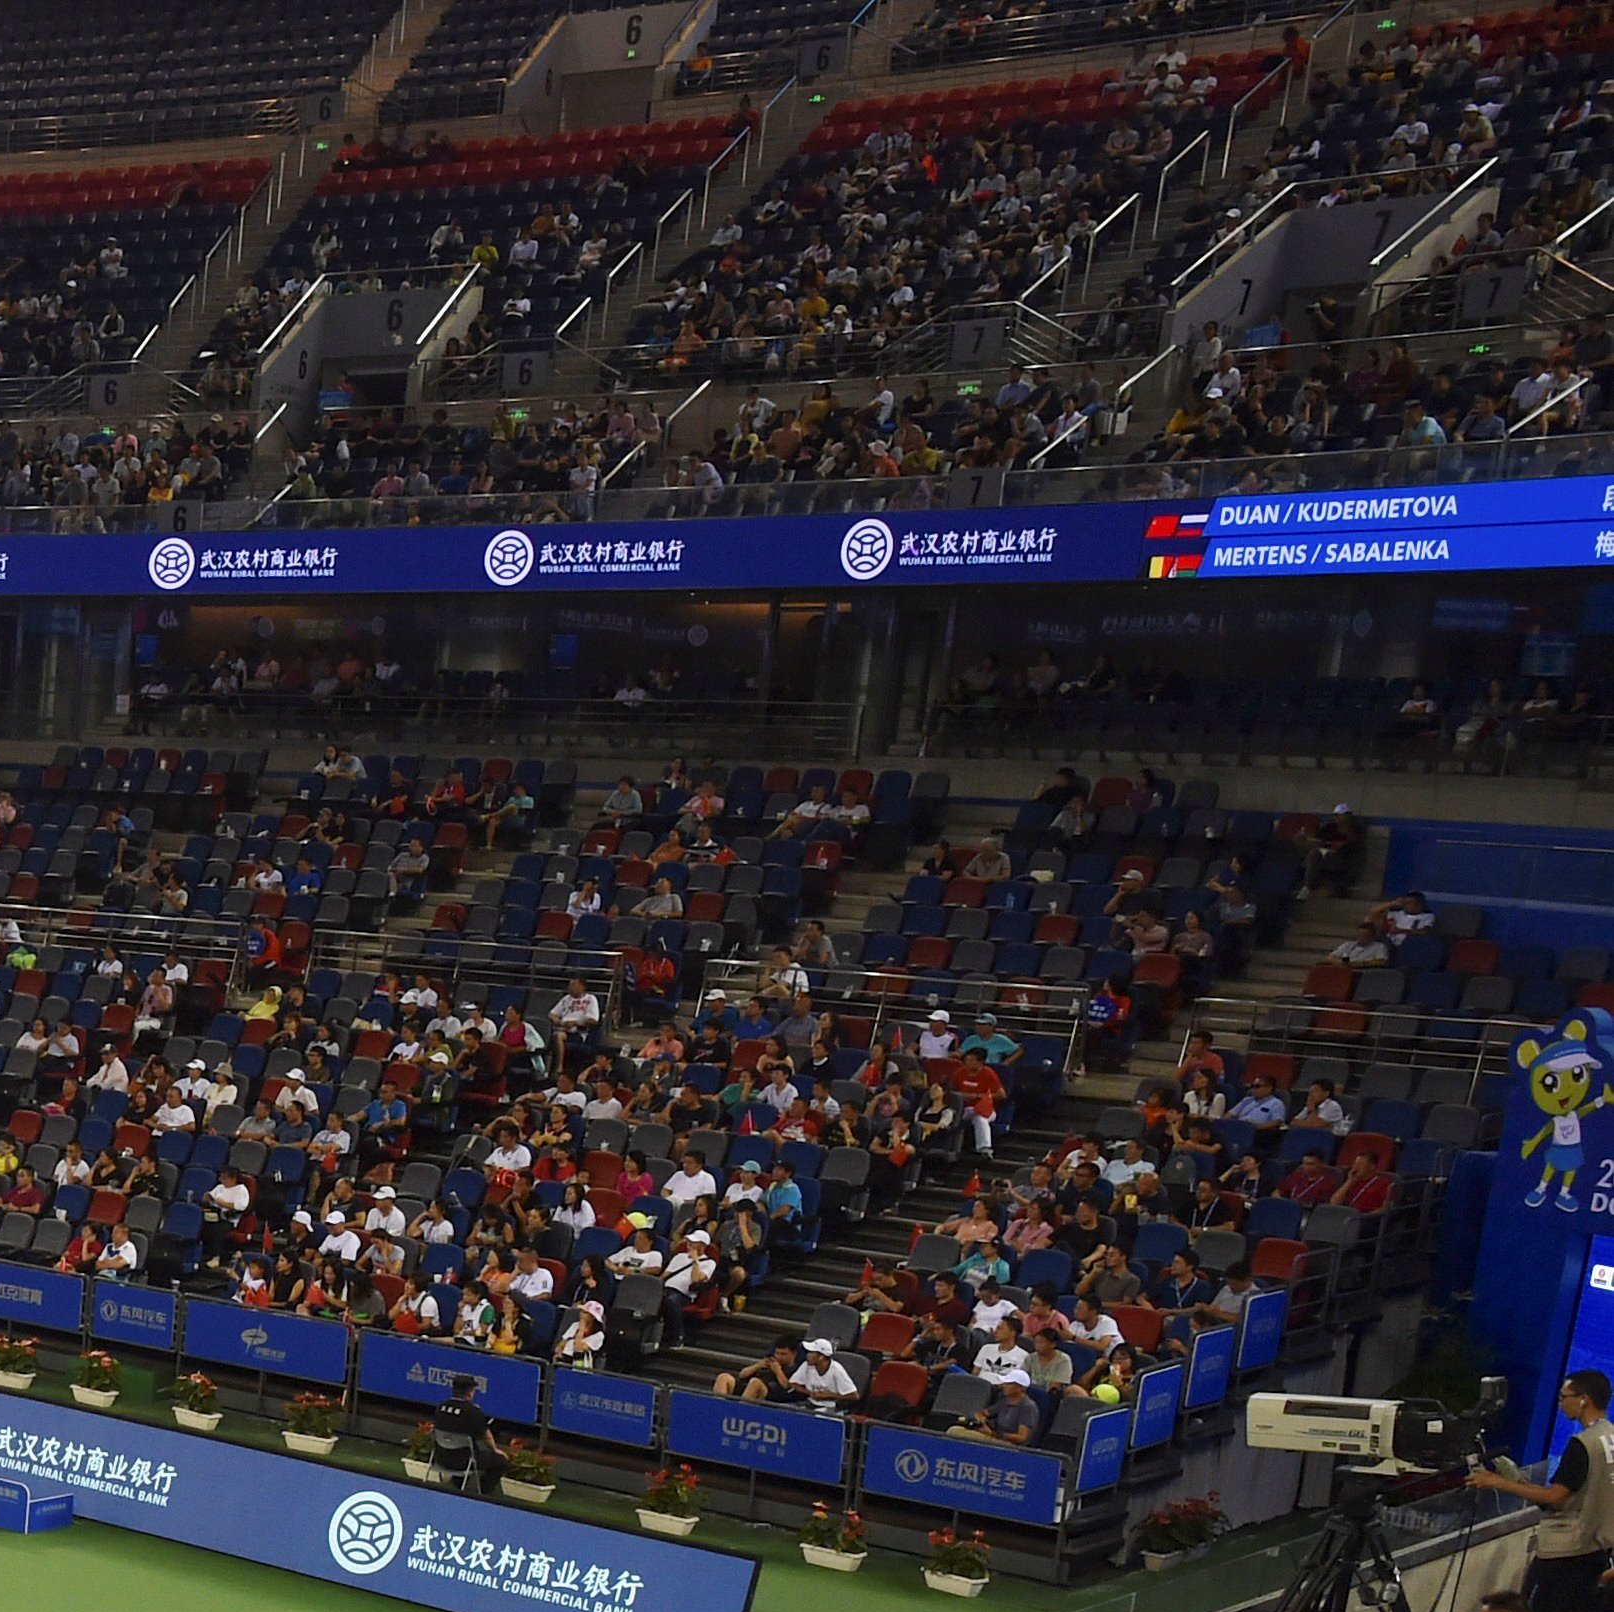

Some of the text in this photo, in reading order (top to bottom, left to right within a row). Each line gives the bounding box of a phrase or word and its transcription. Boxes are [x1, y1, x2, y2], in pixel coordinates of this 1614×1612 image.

[626, 15, 642, 45] 6
[817, 45, 831, 71] 6
[1239, 279, 1252, 315] 7
[387, 299, 404, 330] 6
[972, 327, 985, 354] 7
[519, 358, 533, 386] 6
[104, 380, 117, 405] 6
[971, 476, 983, 503] 7
[1220, 505, 1280, 525] DUAN
[1283, 503, 1294, 523] /
[1297, 495, 1457, 522] KUDERMETOVA
[540, 540, 685, 563] 武汉农村商业银行
[900, 528, 1057, 554] 武汉农村商业银行
[1214, 544, 1312, 566] MERTENS
[1311, 543, 1322, 564] /
[1325, 540, 1449, 563] SABALENKA
[201, 548, 338, 568] 武汉农村商业银行
[722, 1417, 787, 1446] WSDI
[32, 1463, 64, 1482] RURAL
[67, 1472, 136, 1498] COMMERCIAL
[138, 1488, 170, 1507] BANK
[935, 1457, 1026, 1490] 东风汽车
[409, 1525, 644, 1606] 武汉农村商业银行
[407, 1556, 455, 1578] WUHAN
[458, 1568, 499, 1590] RURAL
[502, 1579, 590, 1611] COMMERCIAL
